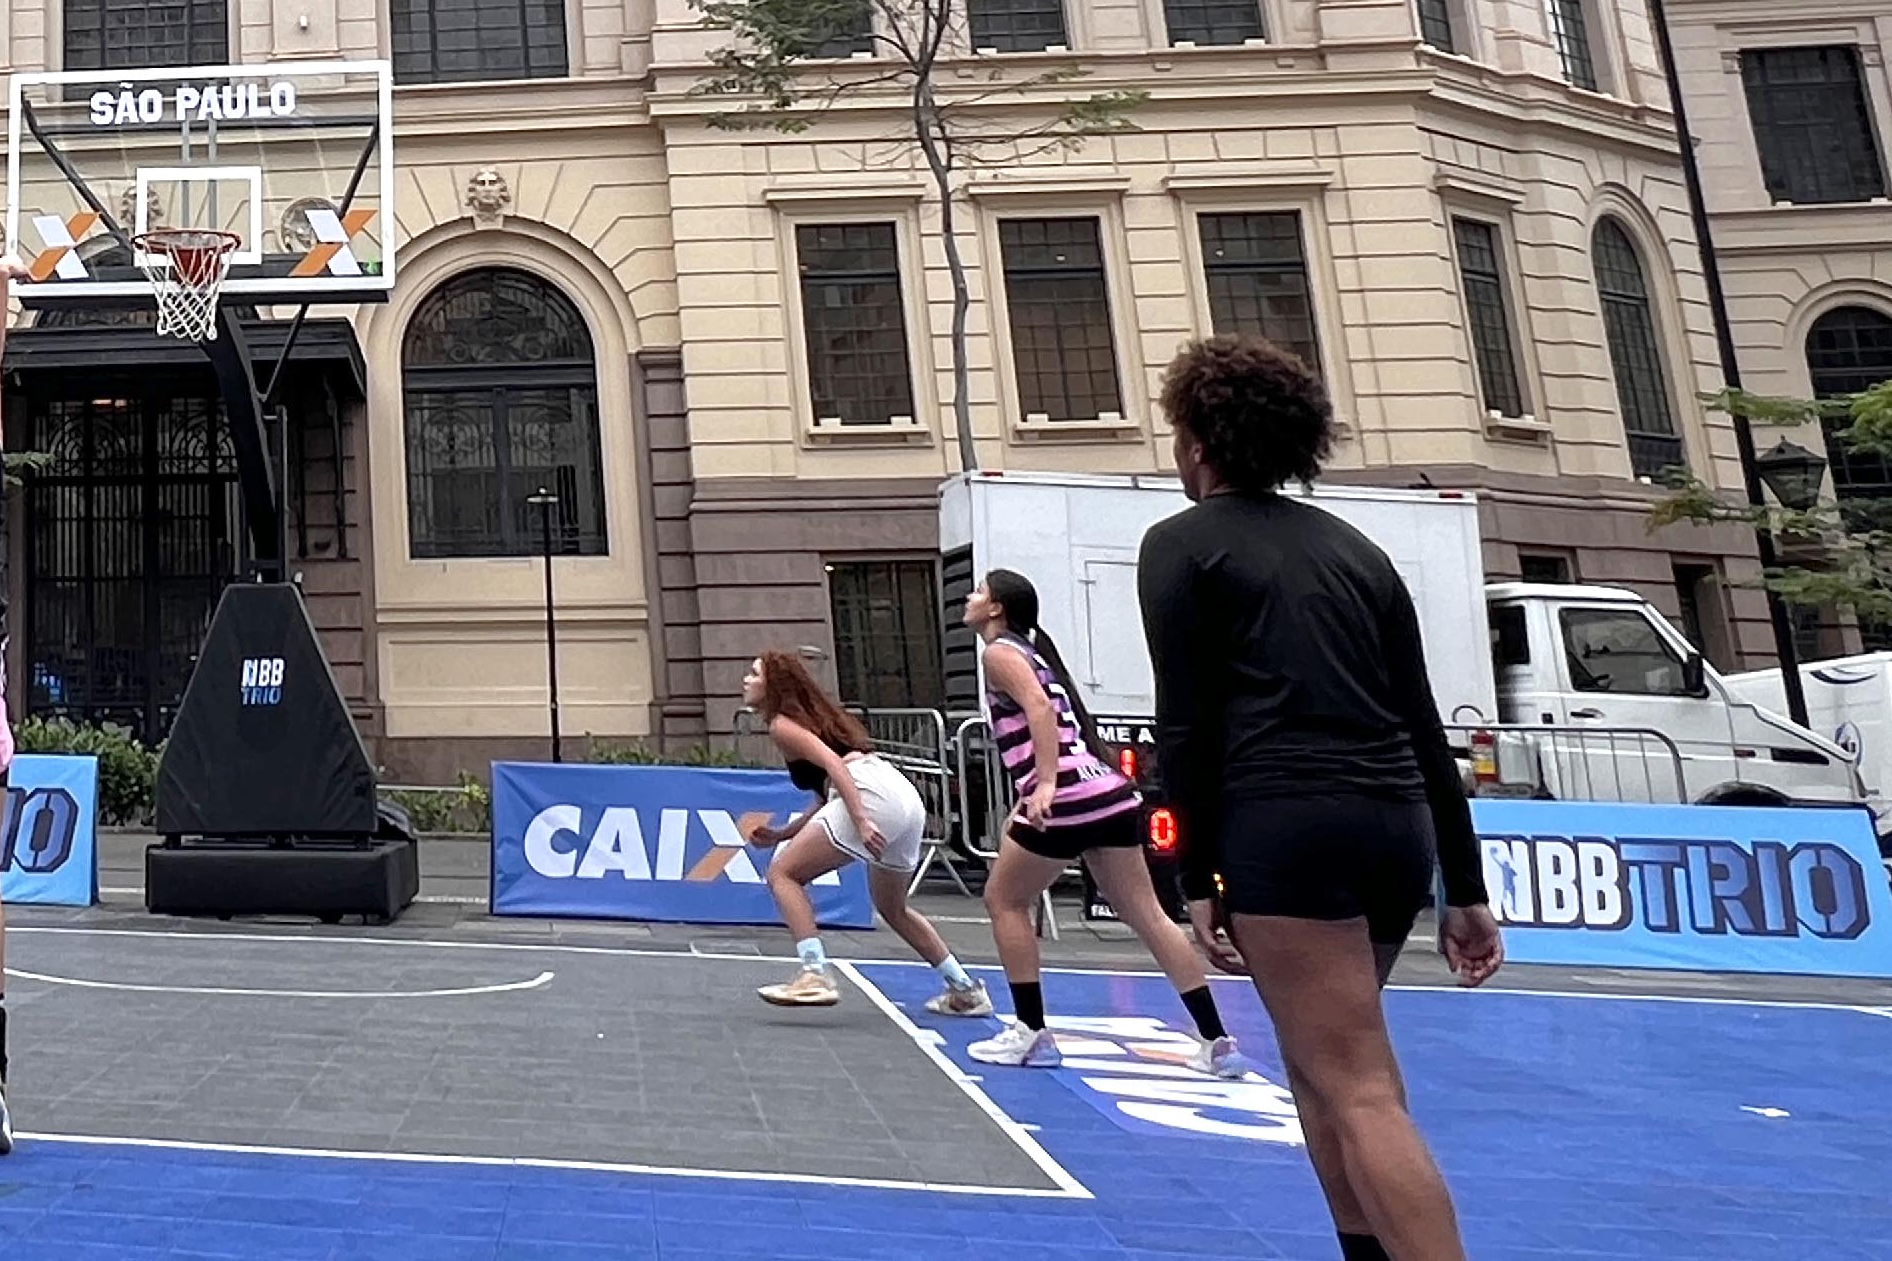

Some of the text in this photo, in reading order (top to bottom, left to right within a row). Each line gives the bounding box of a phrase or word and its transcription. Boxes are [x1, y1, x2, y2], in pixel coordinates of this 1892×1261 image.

[90, 82, 296, 126] SÃO PAULO
[242, 658, 284, 687] NBB
[241, 687, 281, 705] TRIO
[1482, 838, 1859, 934] NBB TRIO
